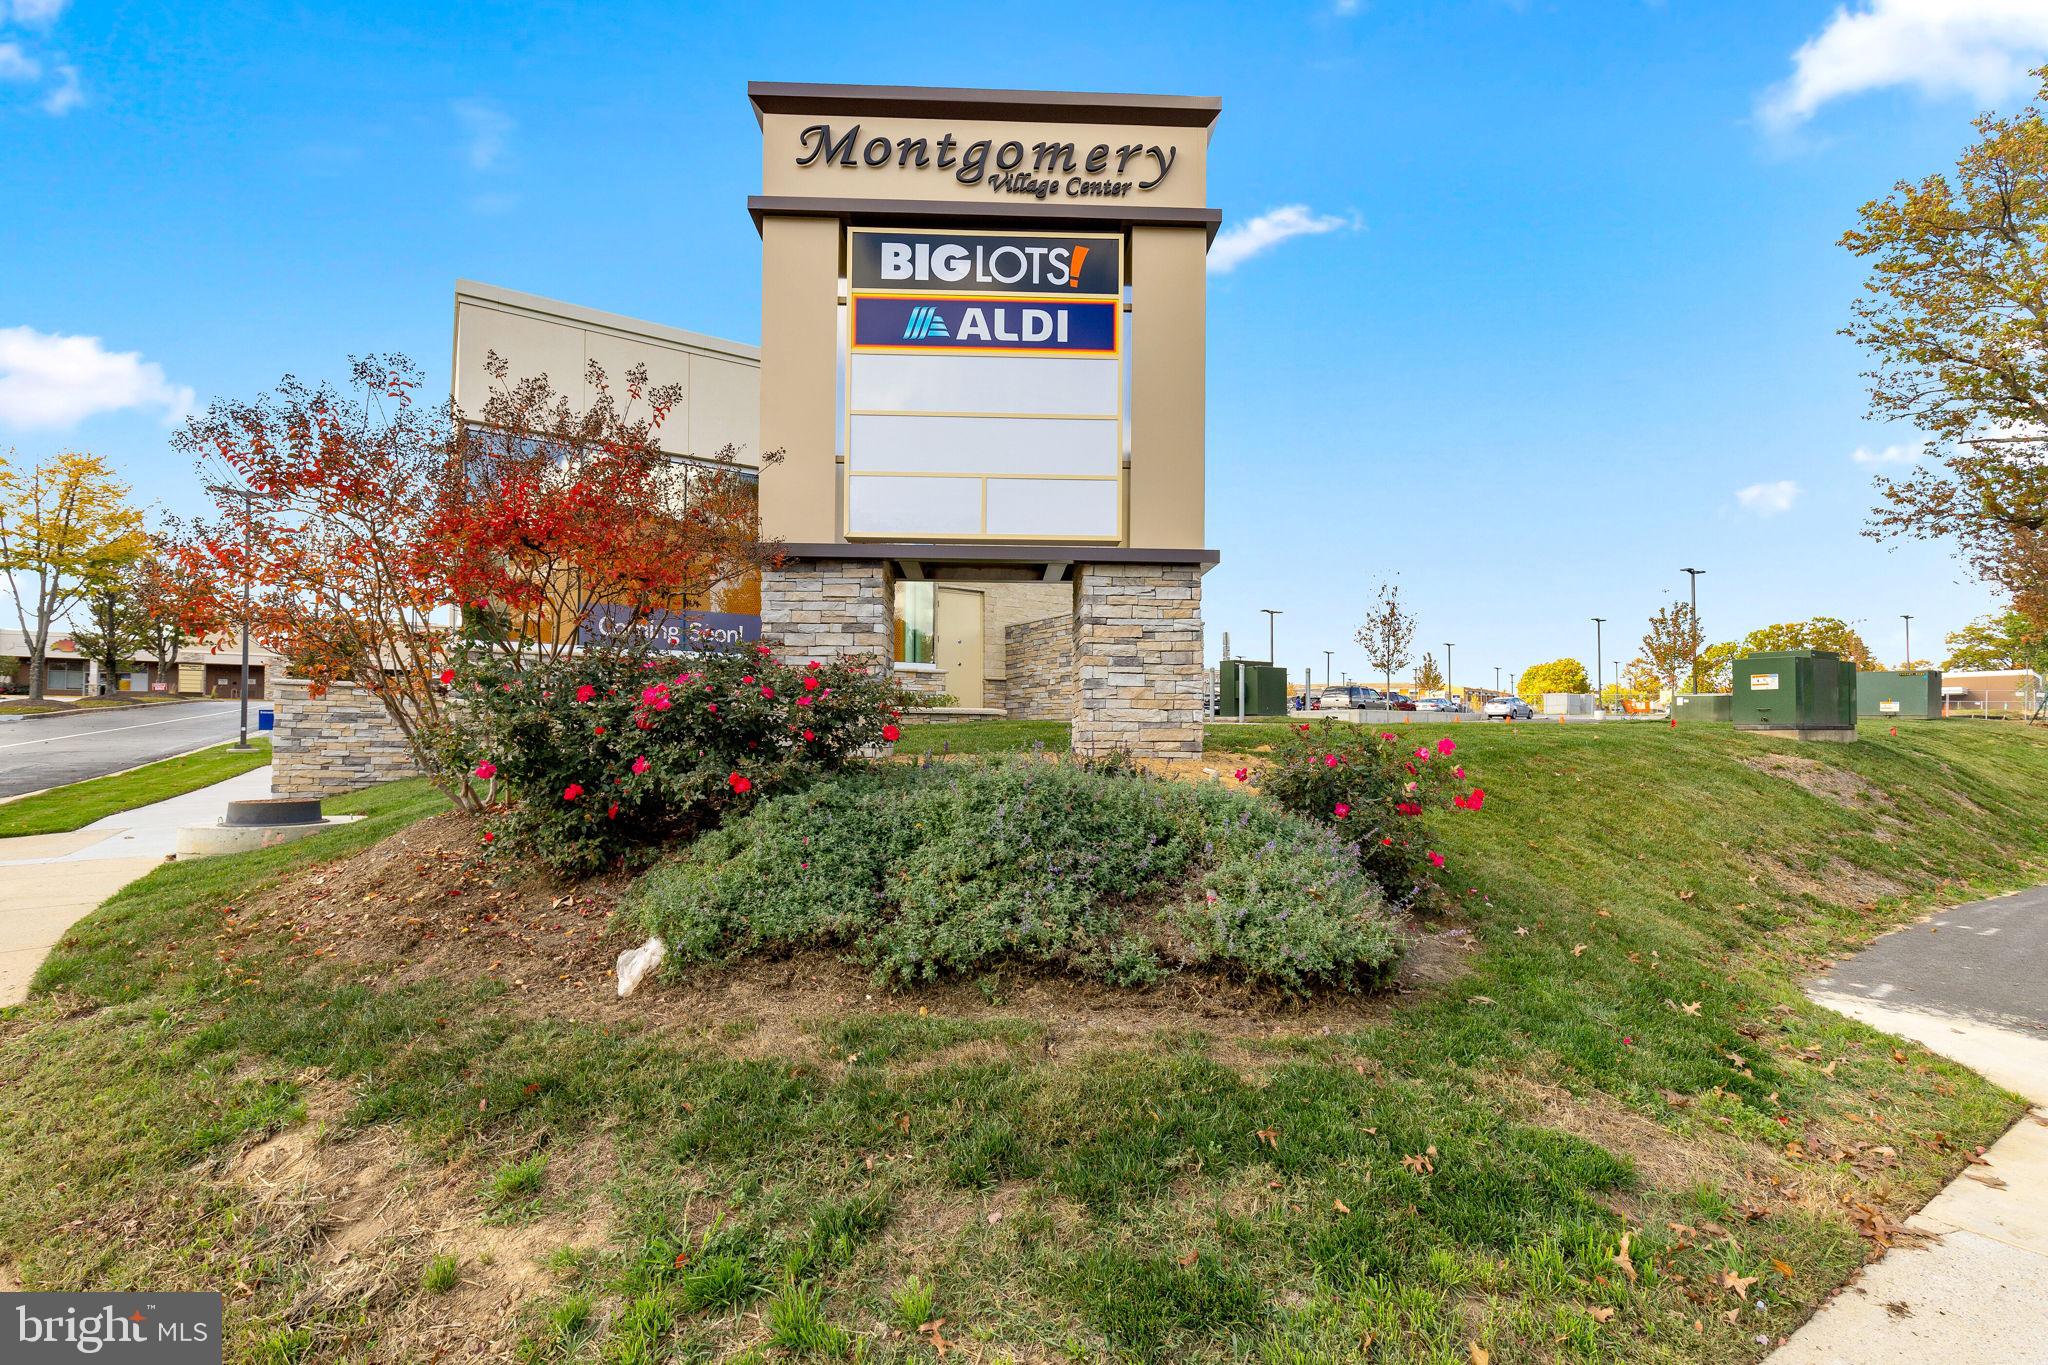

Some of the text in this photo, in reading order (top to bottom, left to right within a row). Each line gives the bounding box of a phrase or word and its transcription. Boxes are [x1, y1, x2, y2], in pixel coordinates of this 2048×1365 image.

[795, 124, 1177, 190] Montgomery
[988, 172, 1133, 199] Village Center
[956, 307, 1069, 343] ALDI
